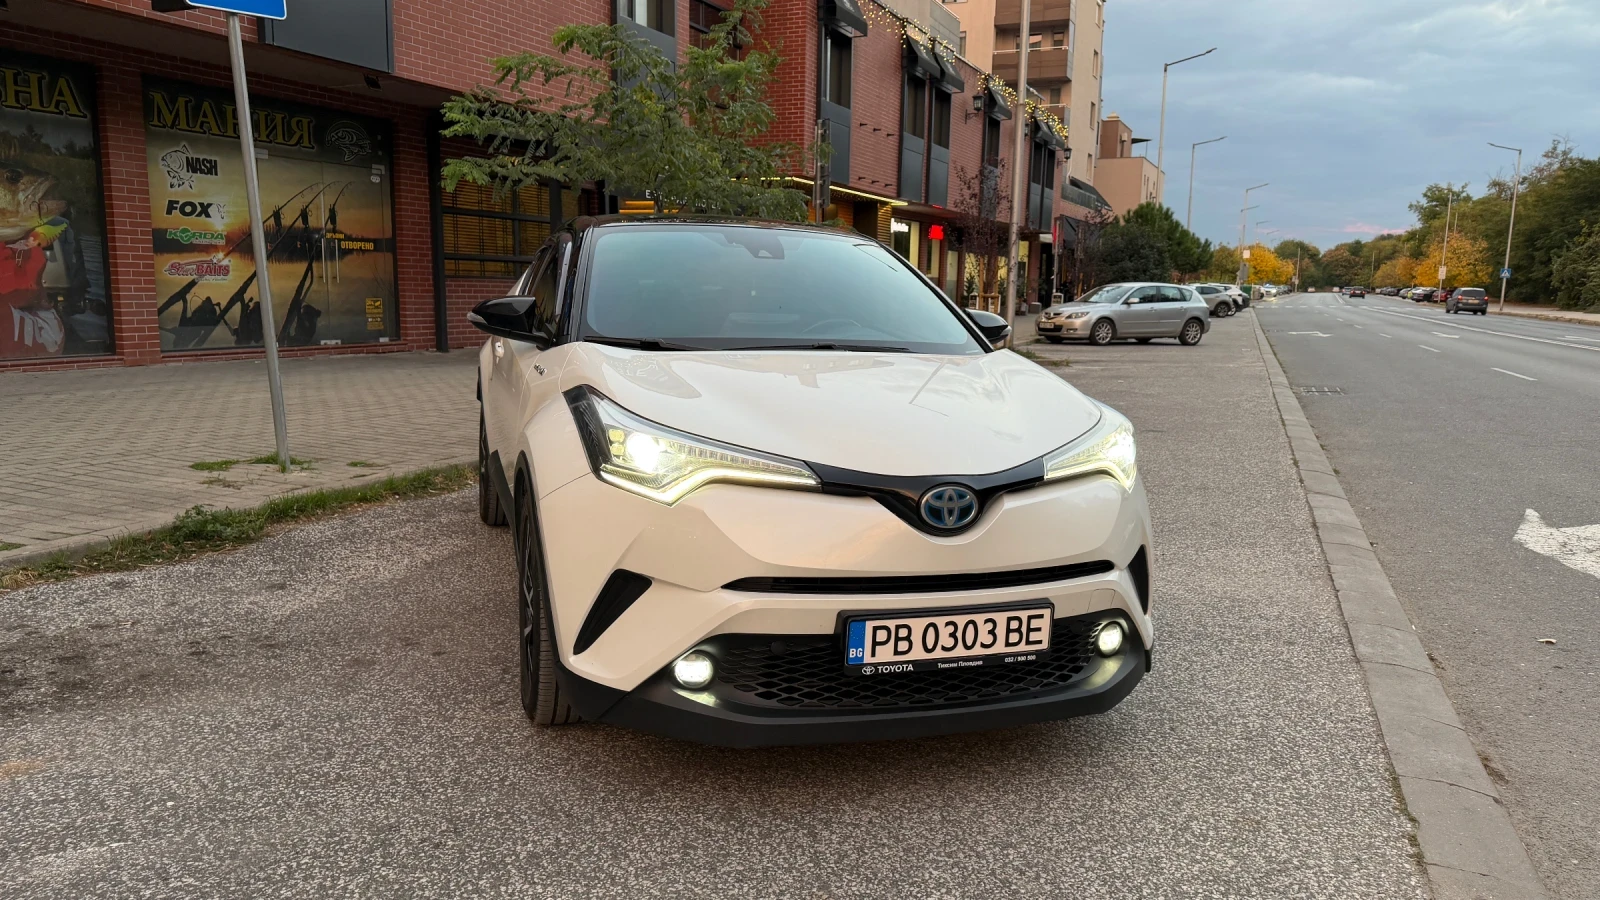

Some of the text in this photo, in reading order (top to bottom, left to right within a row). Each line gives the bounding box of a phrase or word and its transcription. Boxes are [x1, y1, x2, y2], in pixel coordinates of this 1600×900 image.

[185, 156, 218, 176] NASH
[165, 199, 213, 218] FOX
[168, 227, 225, 244] KORDA
[341, 241, 374, 250] ОТВОРЕНО
[871, 614, 1044, 657] PB 0303 BE
[849, 648, 863, 658] BG
[877, 664, 914, 673] TOYOTA
